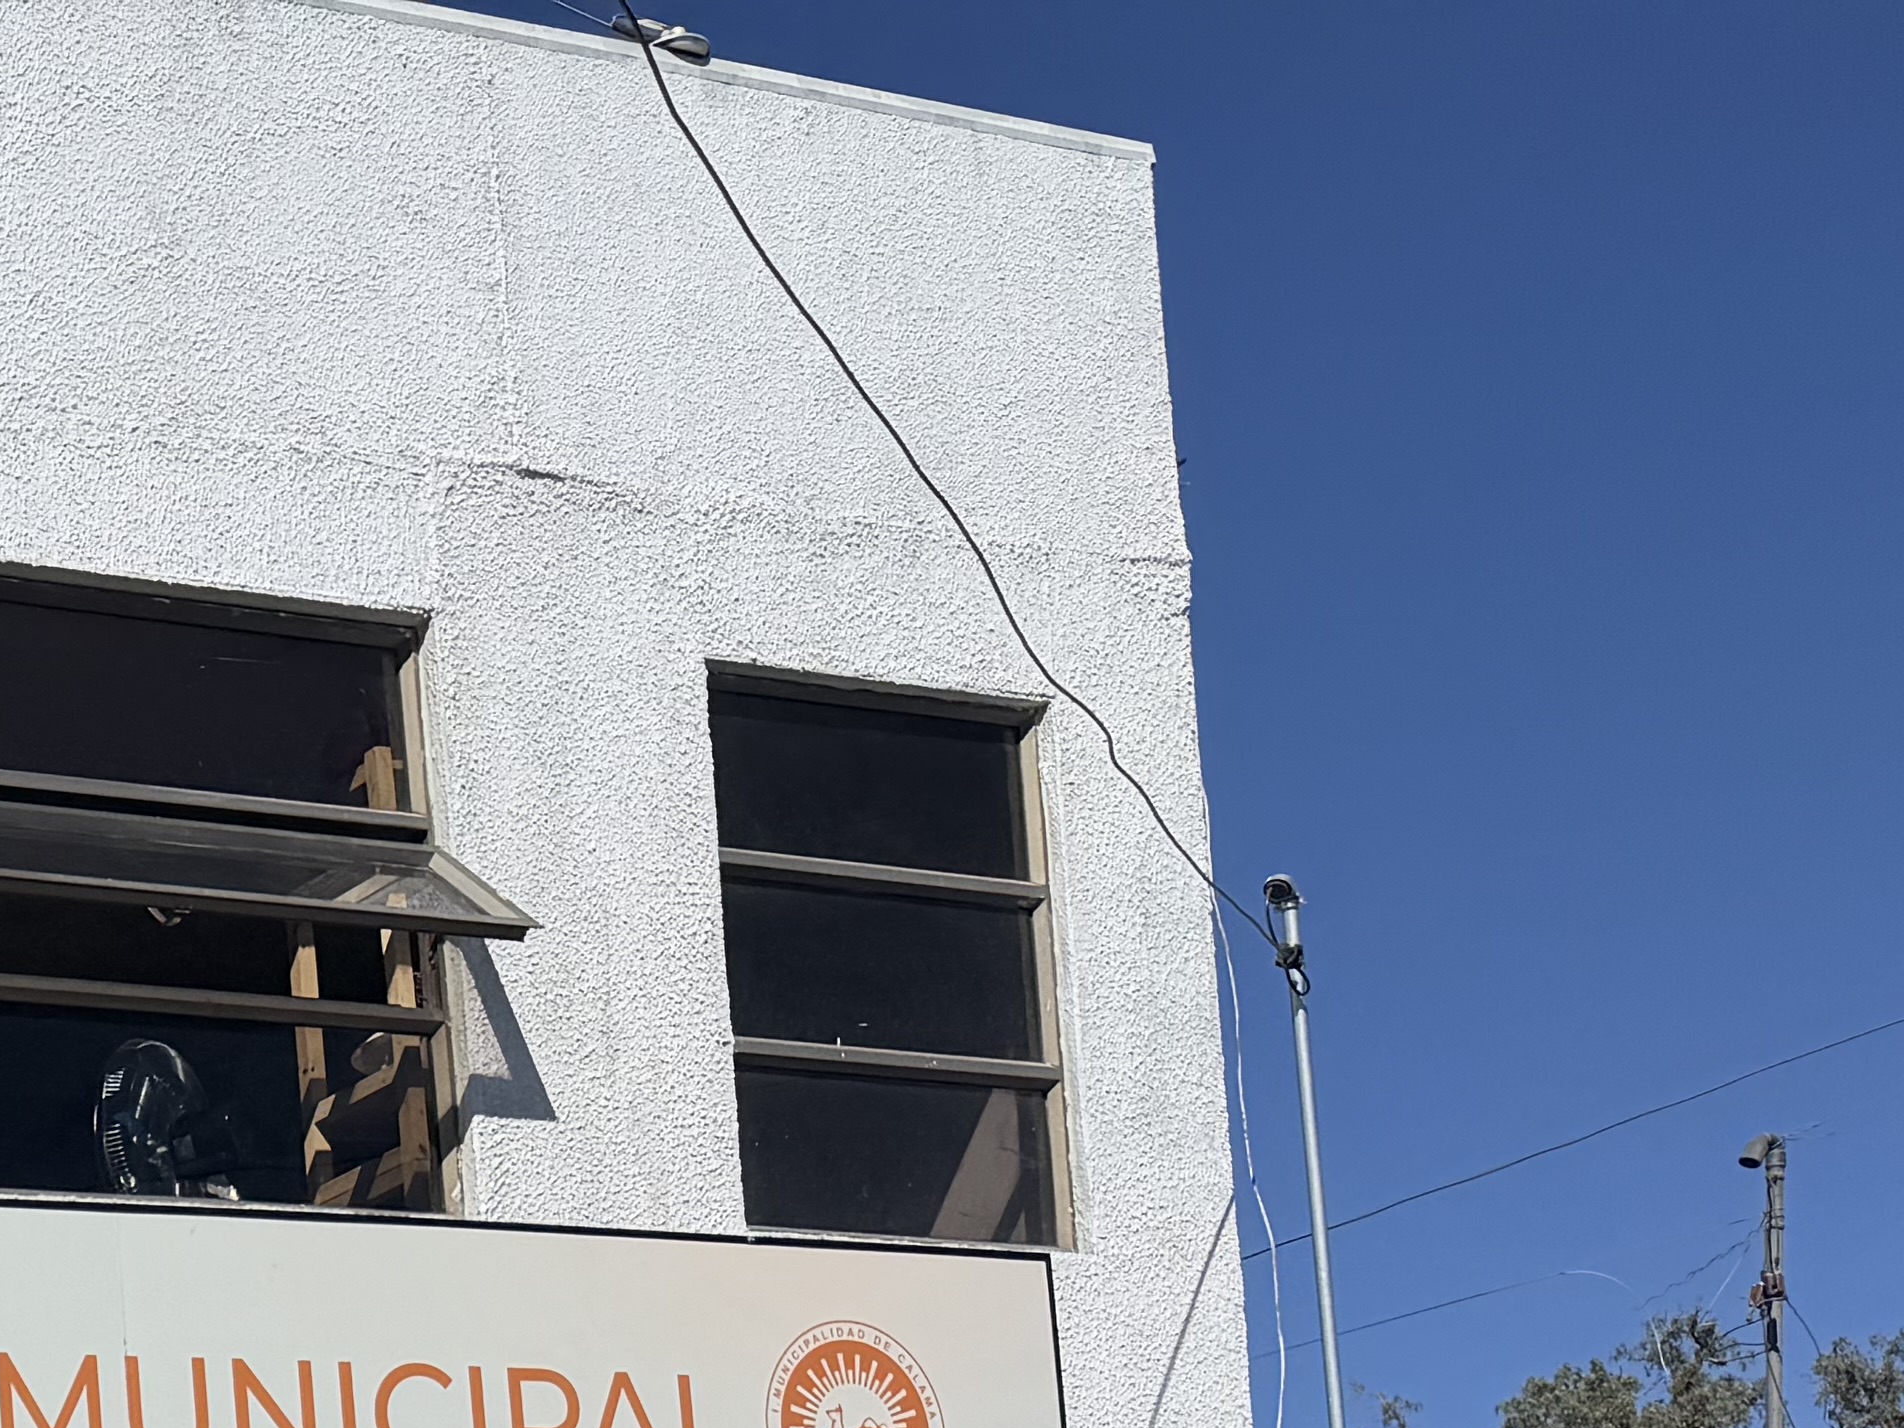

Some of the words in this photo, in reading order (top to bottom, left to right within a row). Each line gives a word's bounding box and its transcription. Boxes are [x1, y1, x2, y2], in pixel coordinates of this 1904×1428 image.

[772, 1326, 865, 1400] MUNICIPALIDAD
[873, 1335, 891, 1352] DE
[897, 1353, 937, 1420] CALAMA
